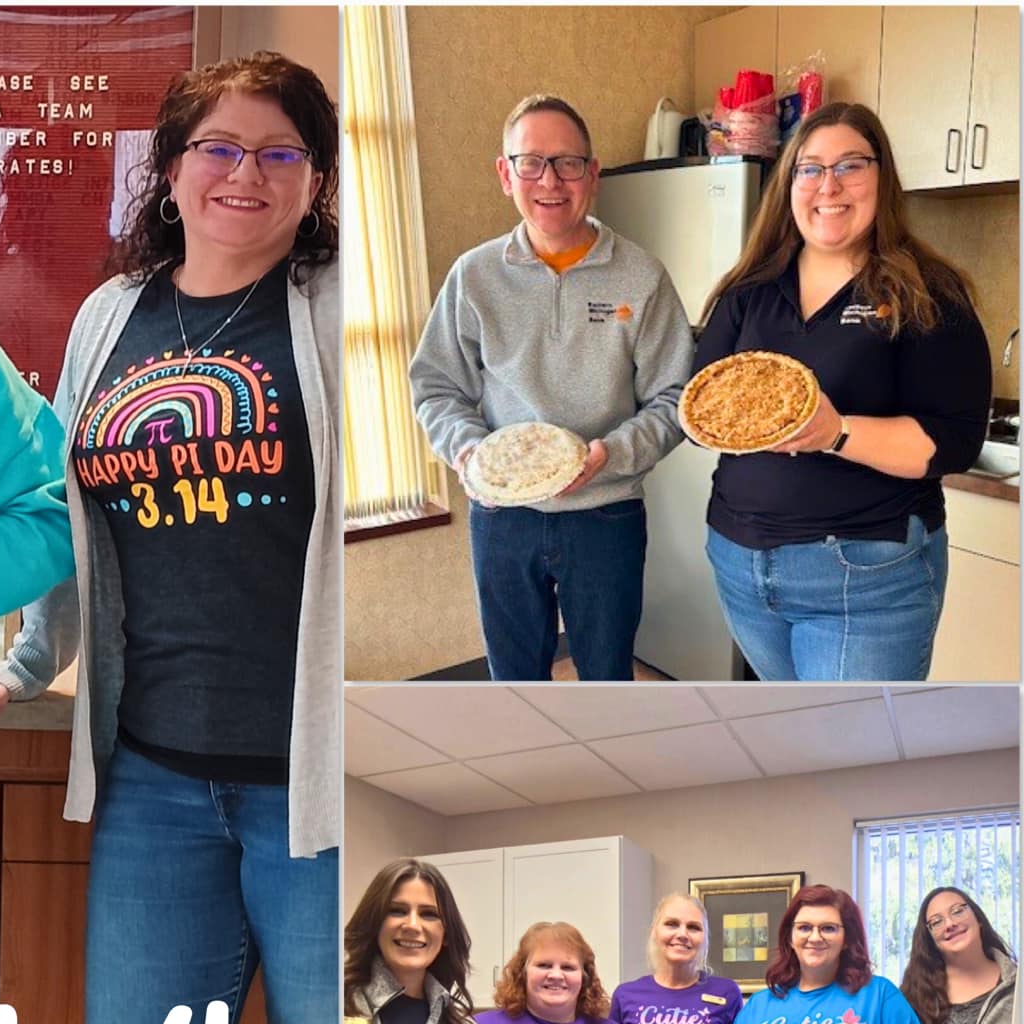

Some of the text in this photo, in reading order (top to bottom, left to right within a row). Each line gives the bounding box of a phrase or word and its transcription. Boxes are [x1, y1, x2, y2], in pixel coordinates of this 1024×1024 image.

[70, 75, 109, 91] SEE
[38, 103, 93, 118] TEAM
[73, 131, 113, 146] FOR
[76, 440, 283, 487] HAPPY PI DAY
[131, 477, 230, 529] 3.14
